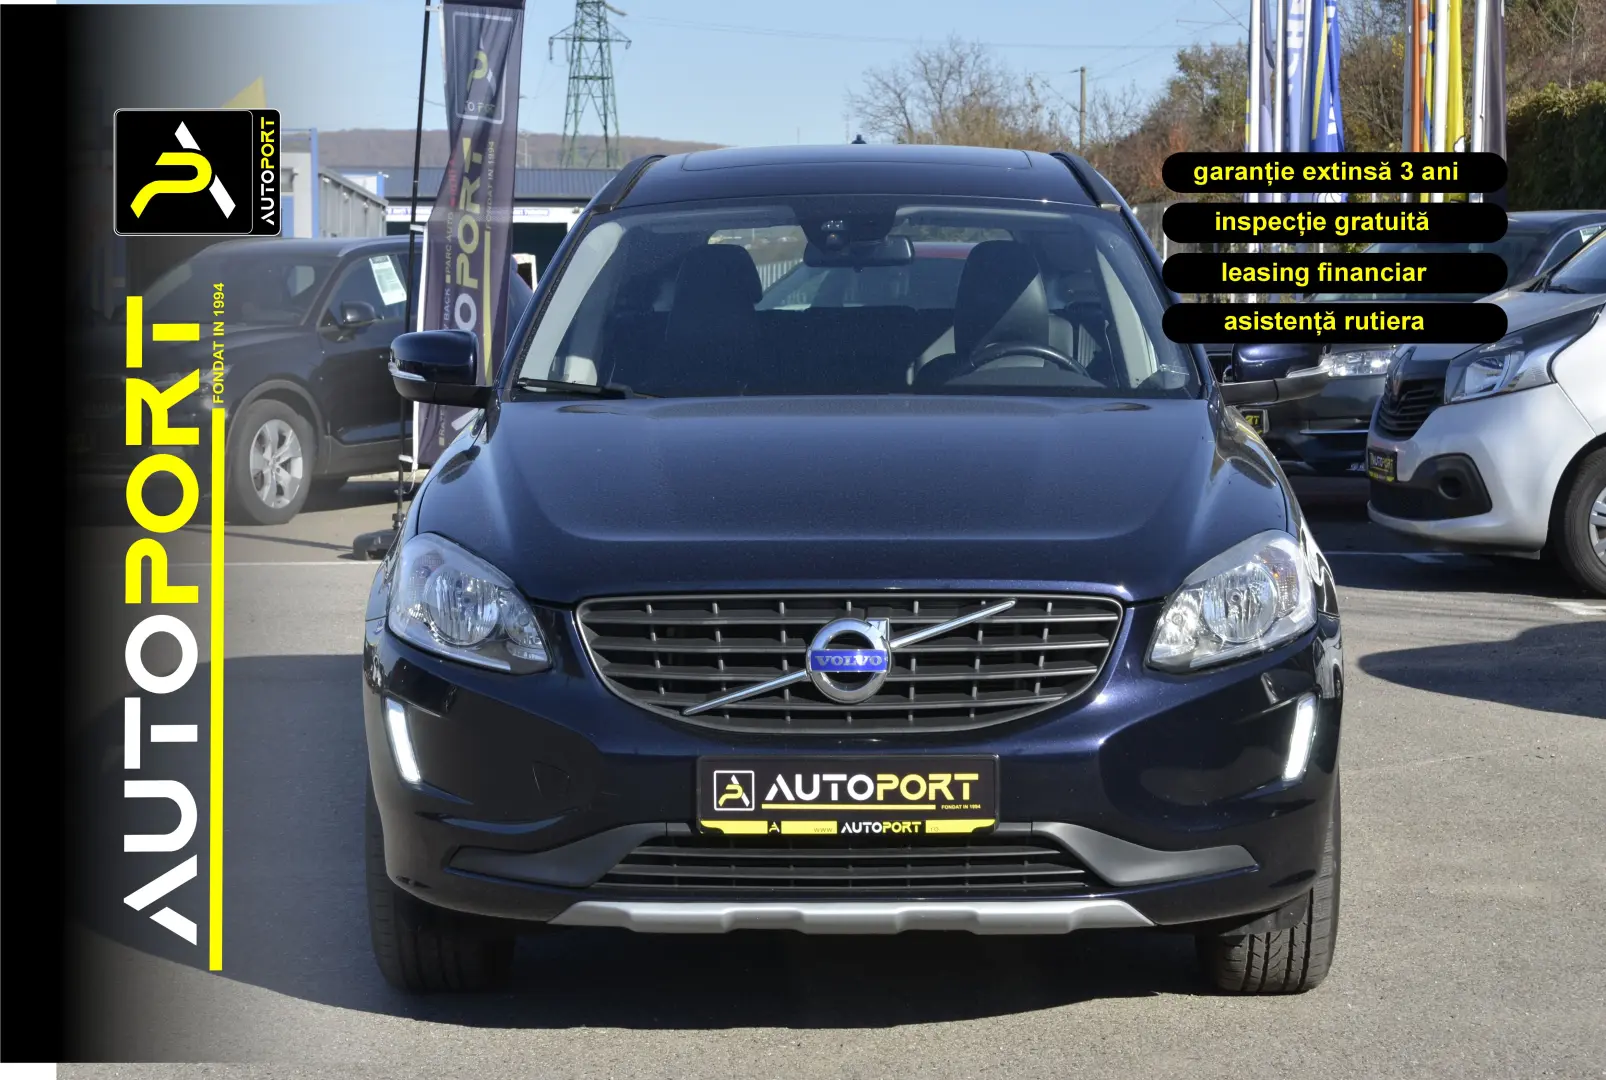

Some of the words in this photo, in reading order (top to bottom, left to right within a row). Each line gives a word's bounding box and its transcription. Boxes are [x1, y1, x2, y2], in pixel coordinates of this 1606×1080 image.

[487, 141, 495, 164] 1994
[487, 169, 494, 180] IN
[443, 288, 452, 321] BACK
[815, 655, 882, 666] VOLVO
[764, 773, 979, 801] AUTOPORT
[840, 821, 922, 833] AUTOPORT
